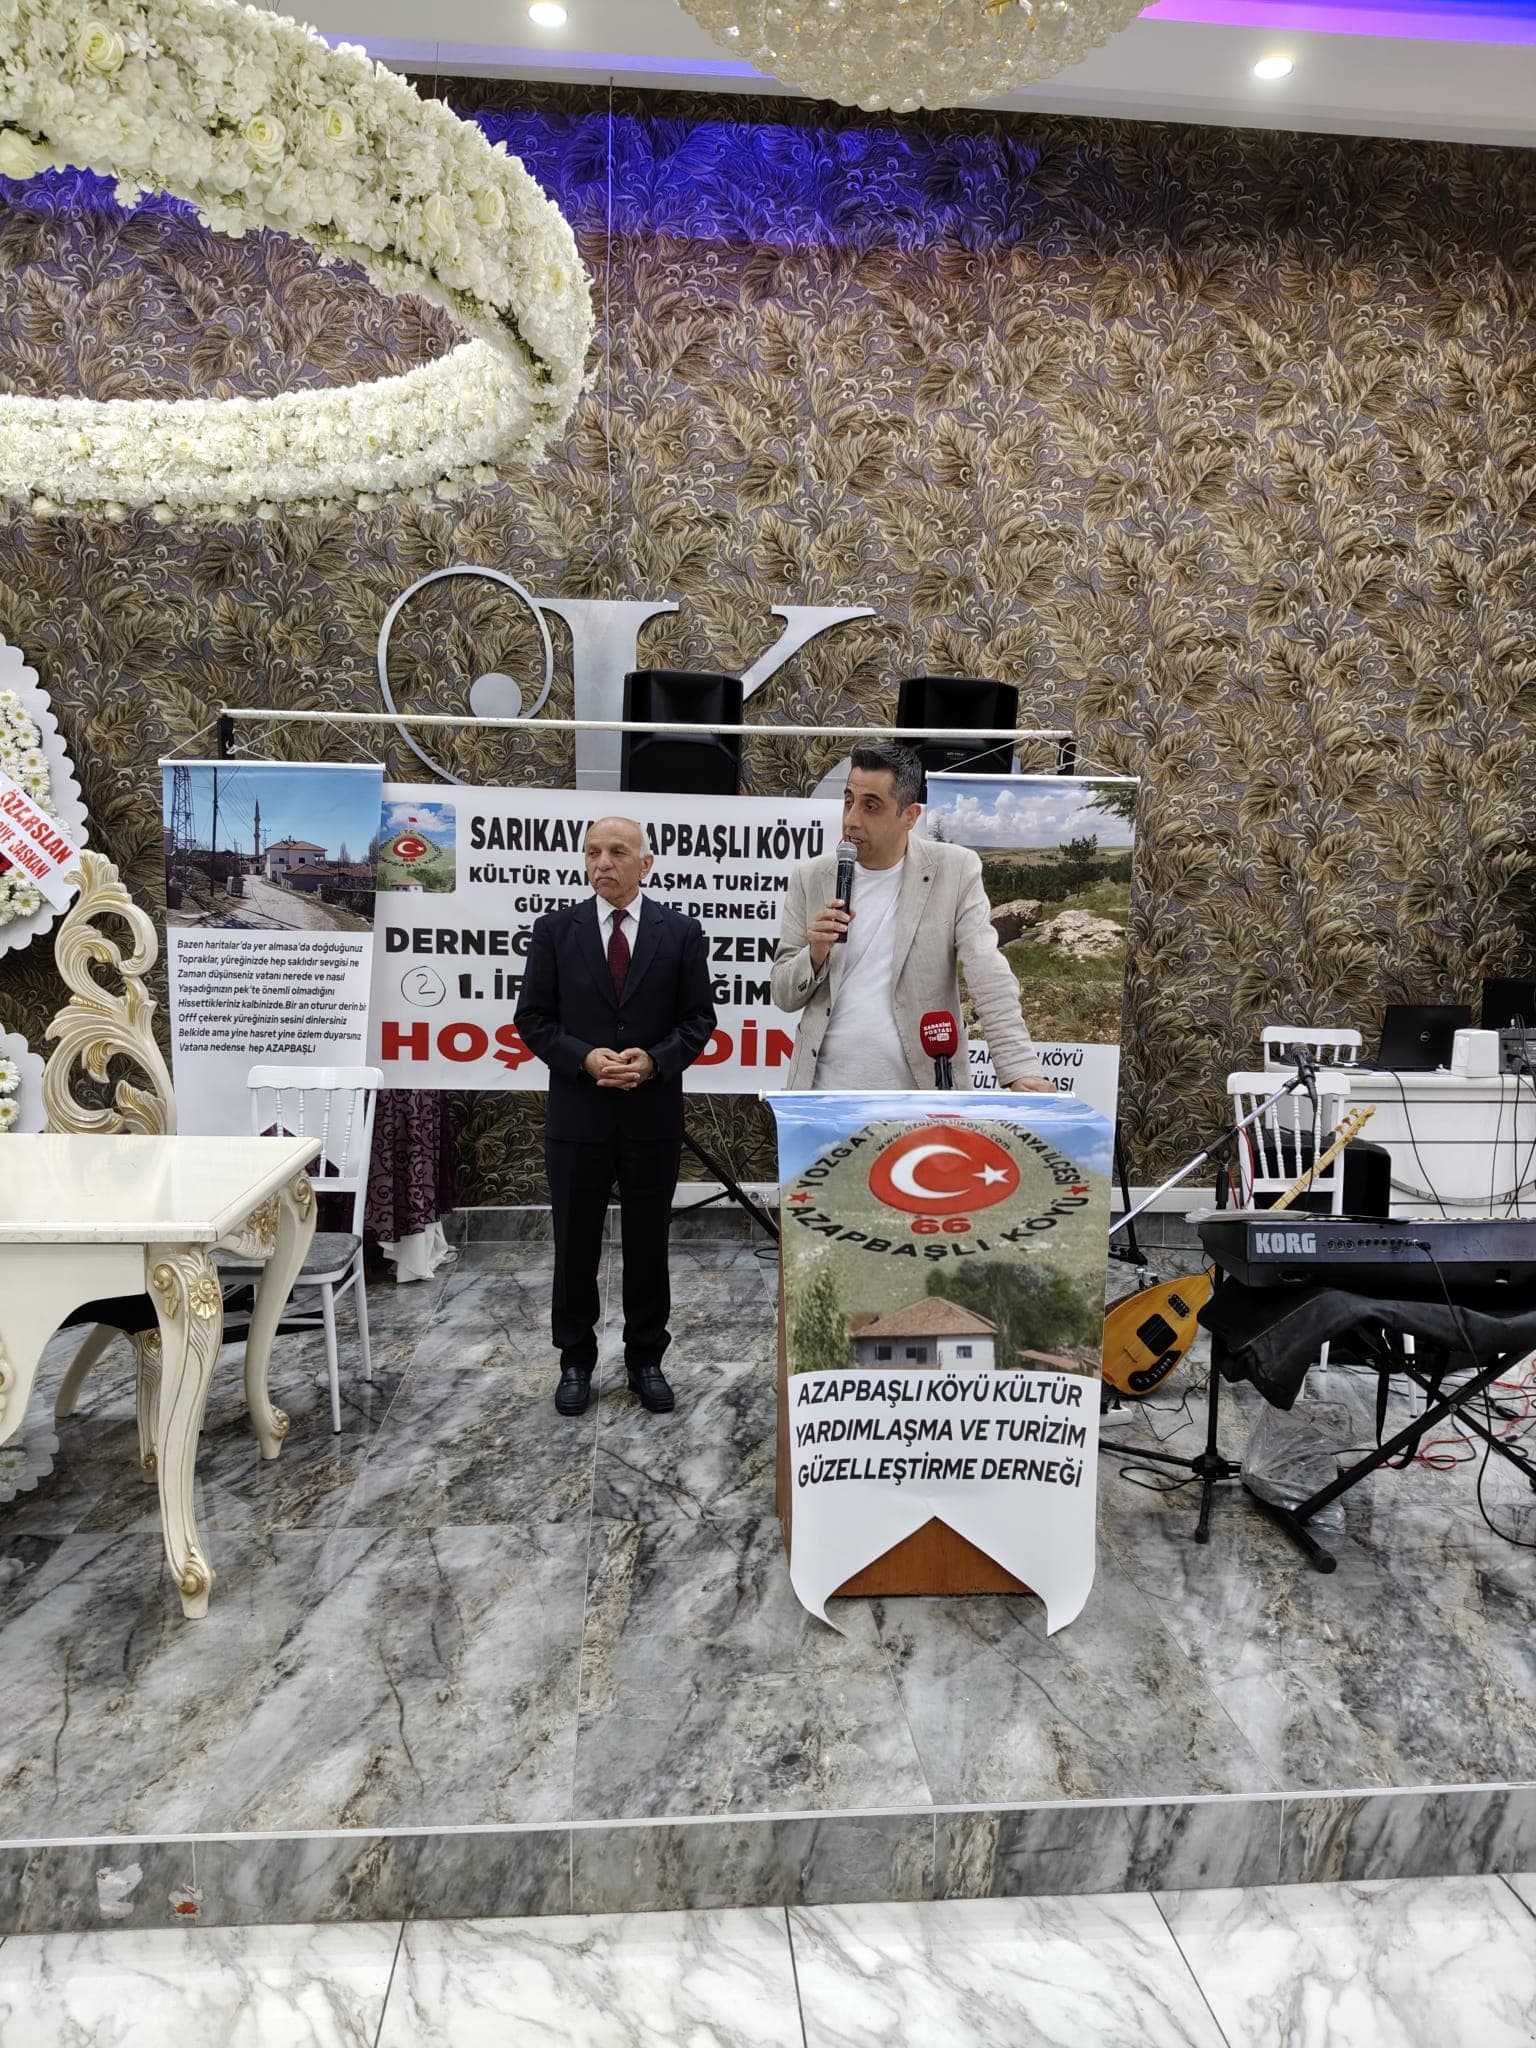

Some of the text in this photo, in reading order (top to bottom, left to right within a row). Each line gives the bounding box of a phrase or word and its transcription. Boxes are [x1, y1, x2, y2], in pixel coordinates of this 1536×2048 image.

[645, 822, 750, 864] APBAŞLI
[757, 819, 824, 860] KÖYÜ
[469, 863, 550, 885] KÜLTÜR
[713, 872, 789, 892] TURİZM
[688, 900, 776, 921] DERNEĞİ
[178, 940, 203, 949] Bazen
[253, 943, 267, 953] yer
[312, 943, 364, 954] doğduğunuz
[386, 925, 533, 956] DERNEĞ
[178, 954, 219, 966] Topraklar,
[220, 956, 268, 967] yüreğinizde
[270, 957, 286, 967] hep
[288, 957, 318, 966] saklıdır
[320, 958, 348, 968] sevgisi
[178, 970, 206, 978] Zaman
[208, 970, 254, 981] düşünseniz
[255, 972, 282, 980] vatanı
[282, 972, 312, 981] nerede
[326, 973, 345, 982] nasıl
[178, 984, 232, 995] Yaşadığınızın
[262, 985, 290, 994] önemli
[292, 986, 335, 997] olmadığını
[178, 999, 240, 1008] Hissettikleriniz
[299, 1002, 309, 1010] an
[310, 1001, 337, 1010] oturur
[339, 1002, 358, 1011] derin
[178, 1013, 347, 1025] Offf çekerek yüreğinizin sesini dinlersiniz
[179, 1029, 210, 1037] Belkide
[231, 1029, 248, 1039] yine
[250, 1029, 276, 1038] hasret
[278, 1030, 295, 1040] yine
[297, 1030, 322, 1039] özlem
[323, 1031, 362, 1041] duyarsınız
[180, 1043, 316, 1055] Vatana nedense hep AZAPBAŞLI
[381, 1021, 536, 1071] HOŞ
[1042, 1049, 1084, 1067] KÖYÜ
[797, 1127, 875, 1188] YOZGAT
[786, 1197, 1089, 1262] AZAPBAŞLI KÖYÜ
[910, 1217, 972, 1235] 66
[1255, 1232, 1317, 1254] KORG
[797, 1374, 1083, 1408] AZAPBAŞLI KÖYÜ KÜLTÜR
[796, 1414, 1087, 1449] YARDIMLAŞMA VE TURİZİM
[798, 1451, 1083, 1488] GÜZELLEŞTİRME DERNEĞİ
